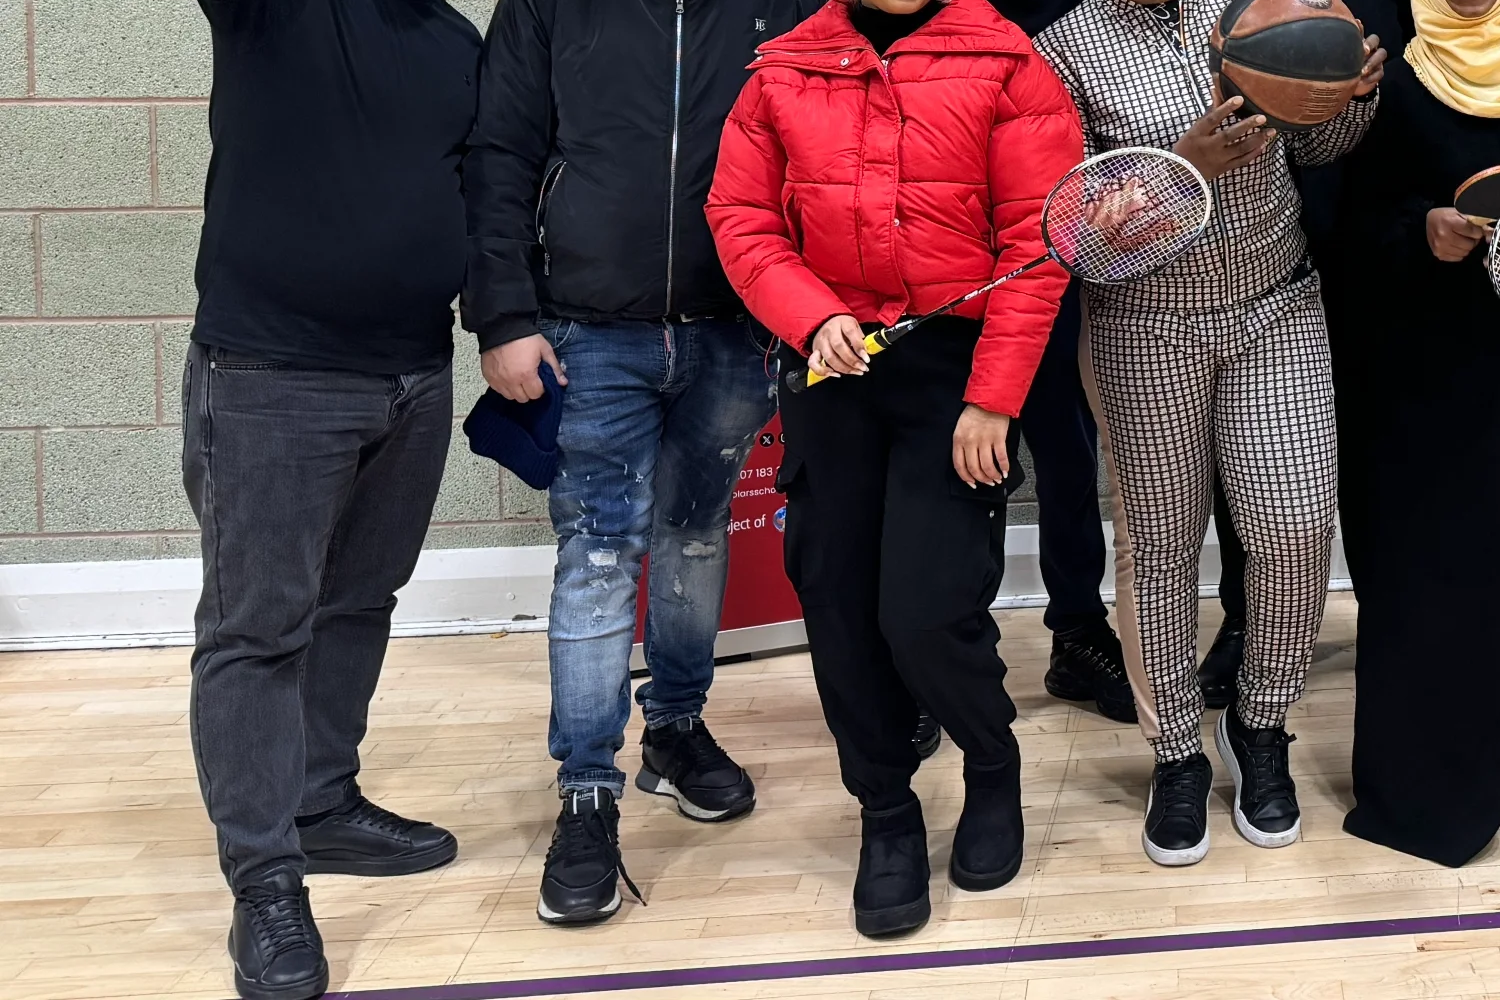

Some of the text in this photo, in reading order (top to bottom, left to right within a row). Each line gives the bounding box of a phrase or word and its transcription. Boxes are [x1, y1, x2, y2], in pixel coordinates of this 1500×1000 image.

[738, 467, 773, 480] 07 183
[754, 514, 766, 528] of
